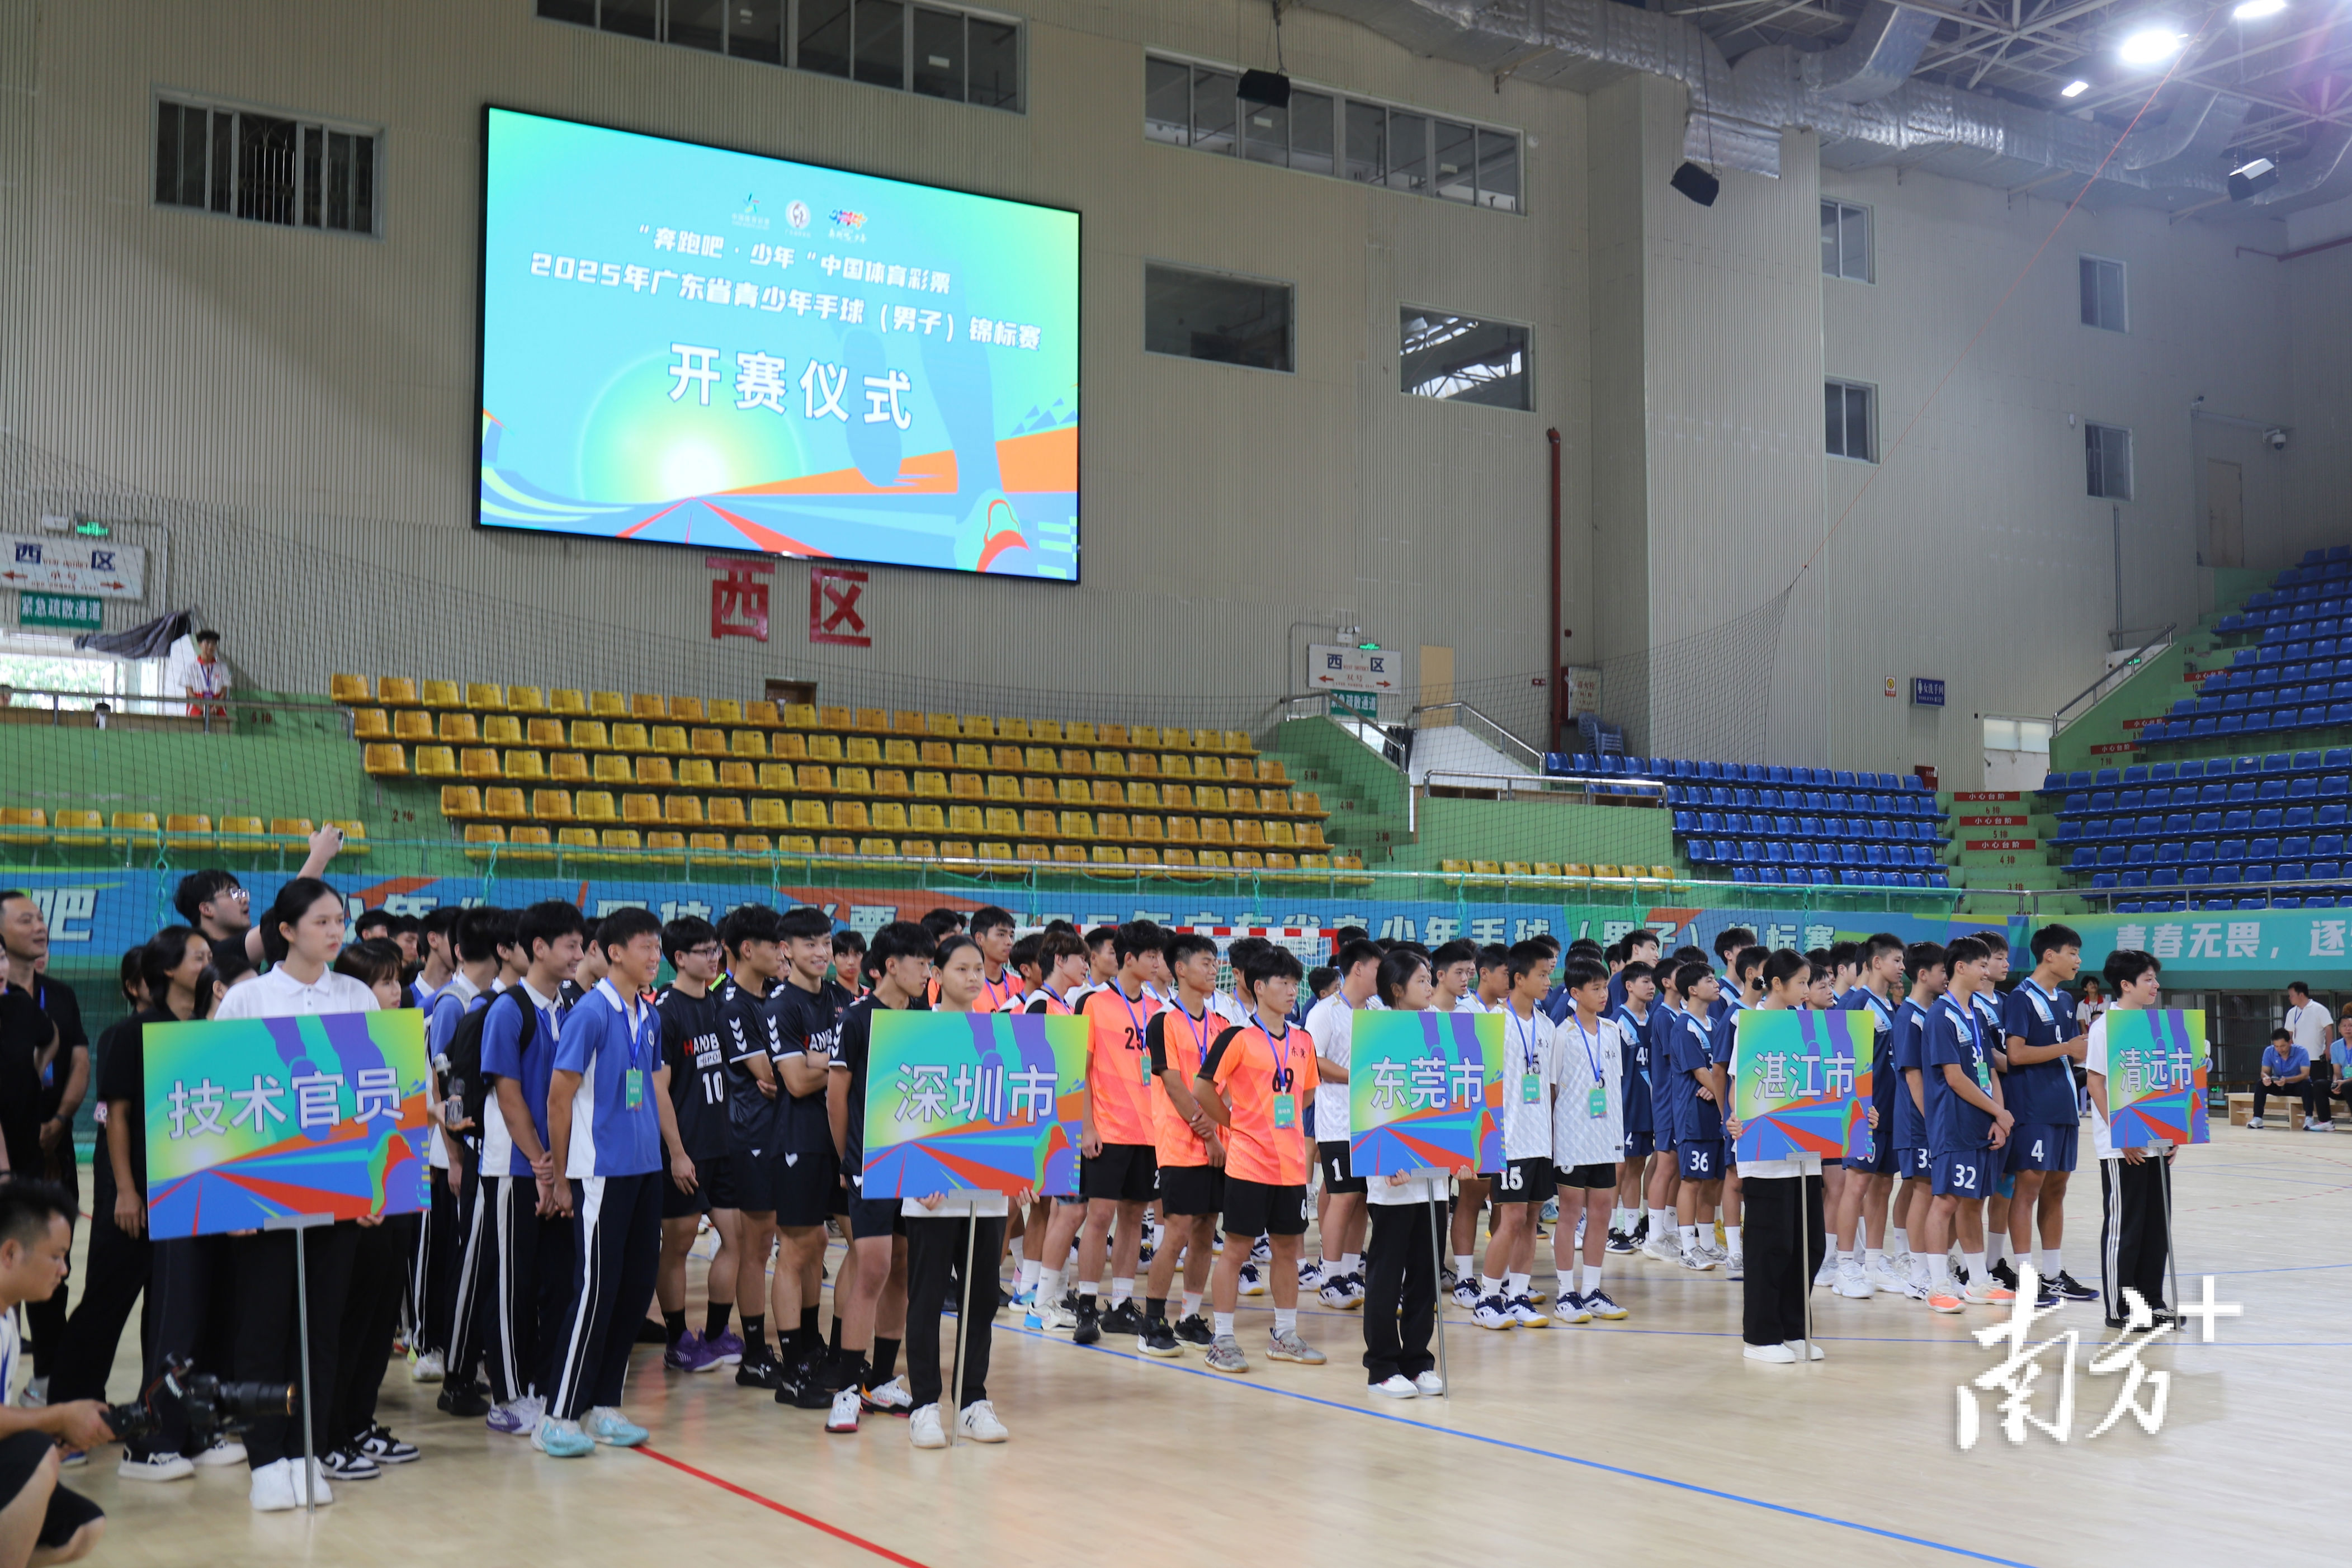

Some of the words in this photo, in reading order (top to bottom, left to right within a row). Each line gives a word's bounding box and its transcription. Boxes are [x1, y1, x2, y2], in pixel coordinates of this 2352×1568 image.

[668, 342, 914, 431] 开赛仪式
[21, 594, 101, 622] 紧急疏散通道
[2101, 744, 2130, 752] 小心台阶
[1371, 1055, 1486, 1110] 东莞市
[1753, 1050, 1857, 1099] 湛江市
[2118, 1046, 2193, 1093] 清远市
[167, 1066, 405, 1140] 技术官员
[702, 1070, 724, 1105] 10
[895, 1062, 1059, 1123] 深圳市
[1689, 1150, 1709, 1172] 36
[2030, 1139, 2045, 1163] 4
[1331, 1157, 1344, 1182] 1
[1500, 1165, 1524, 1191] 15
[1953, 1164, 1977, 1190] 32
